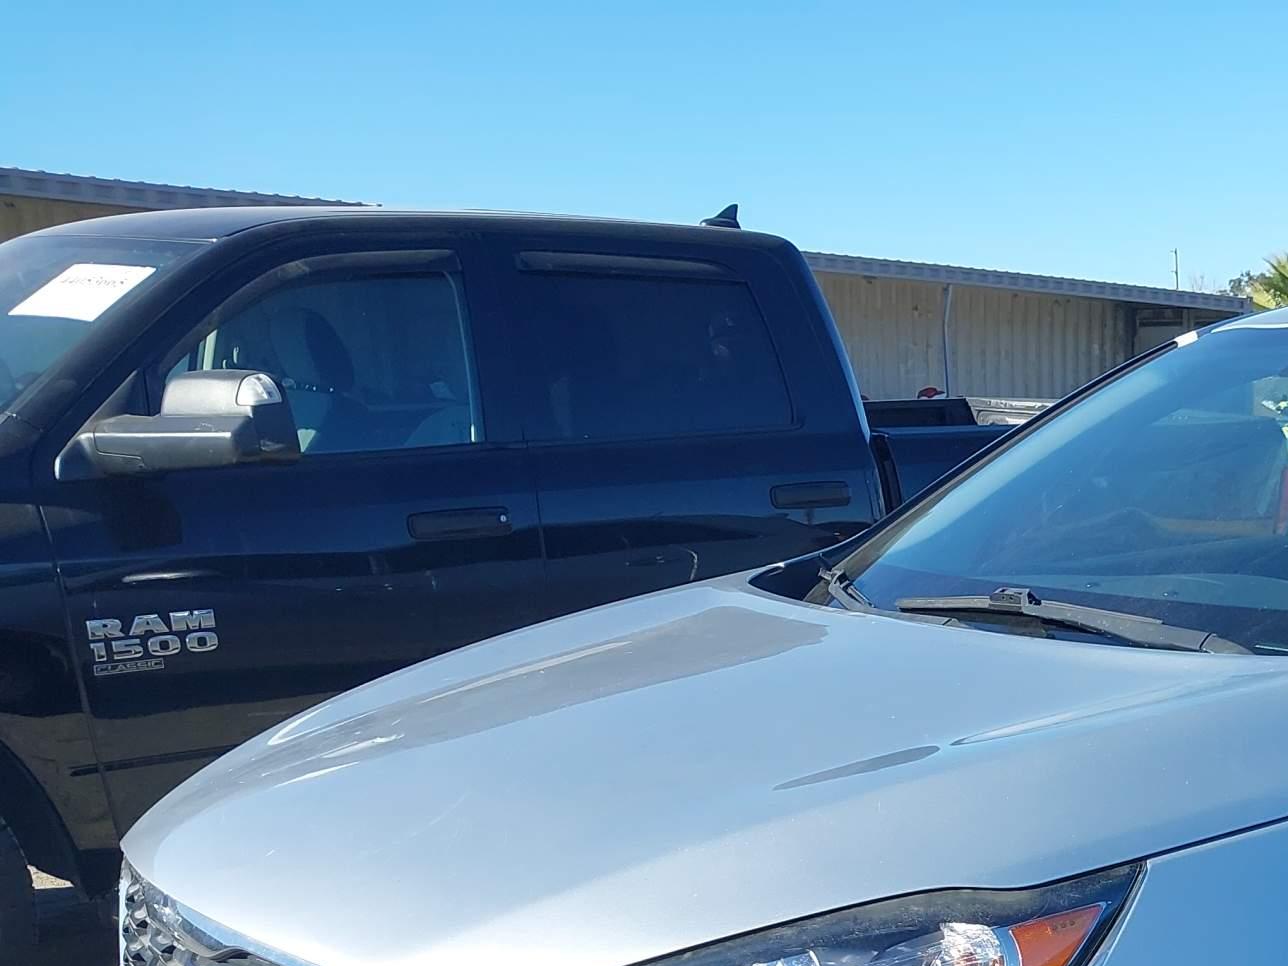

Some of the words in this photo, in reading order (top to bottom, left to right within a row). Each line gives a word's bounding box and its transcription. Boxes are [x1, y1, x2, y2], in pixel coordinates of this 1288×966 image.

[85, 608, 216, 640] RAM
[89, 631, 219, 662] 1500
[95, 658, 163, 674] CLASSIC
